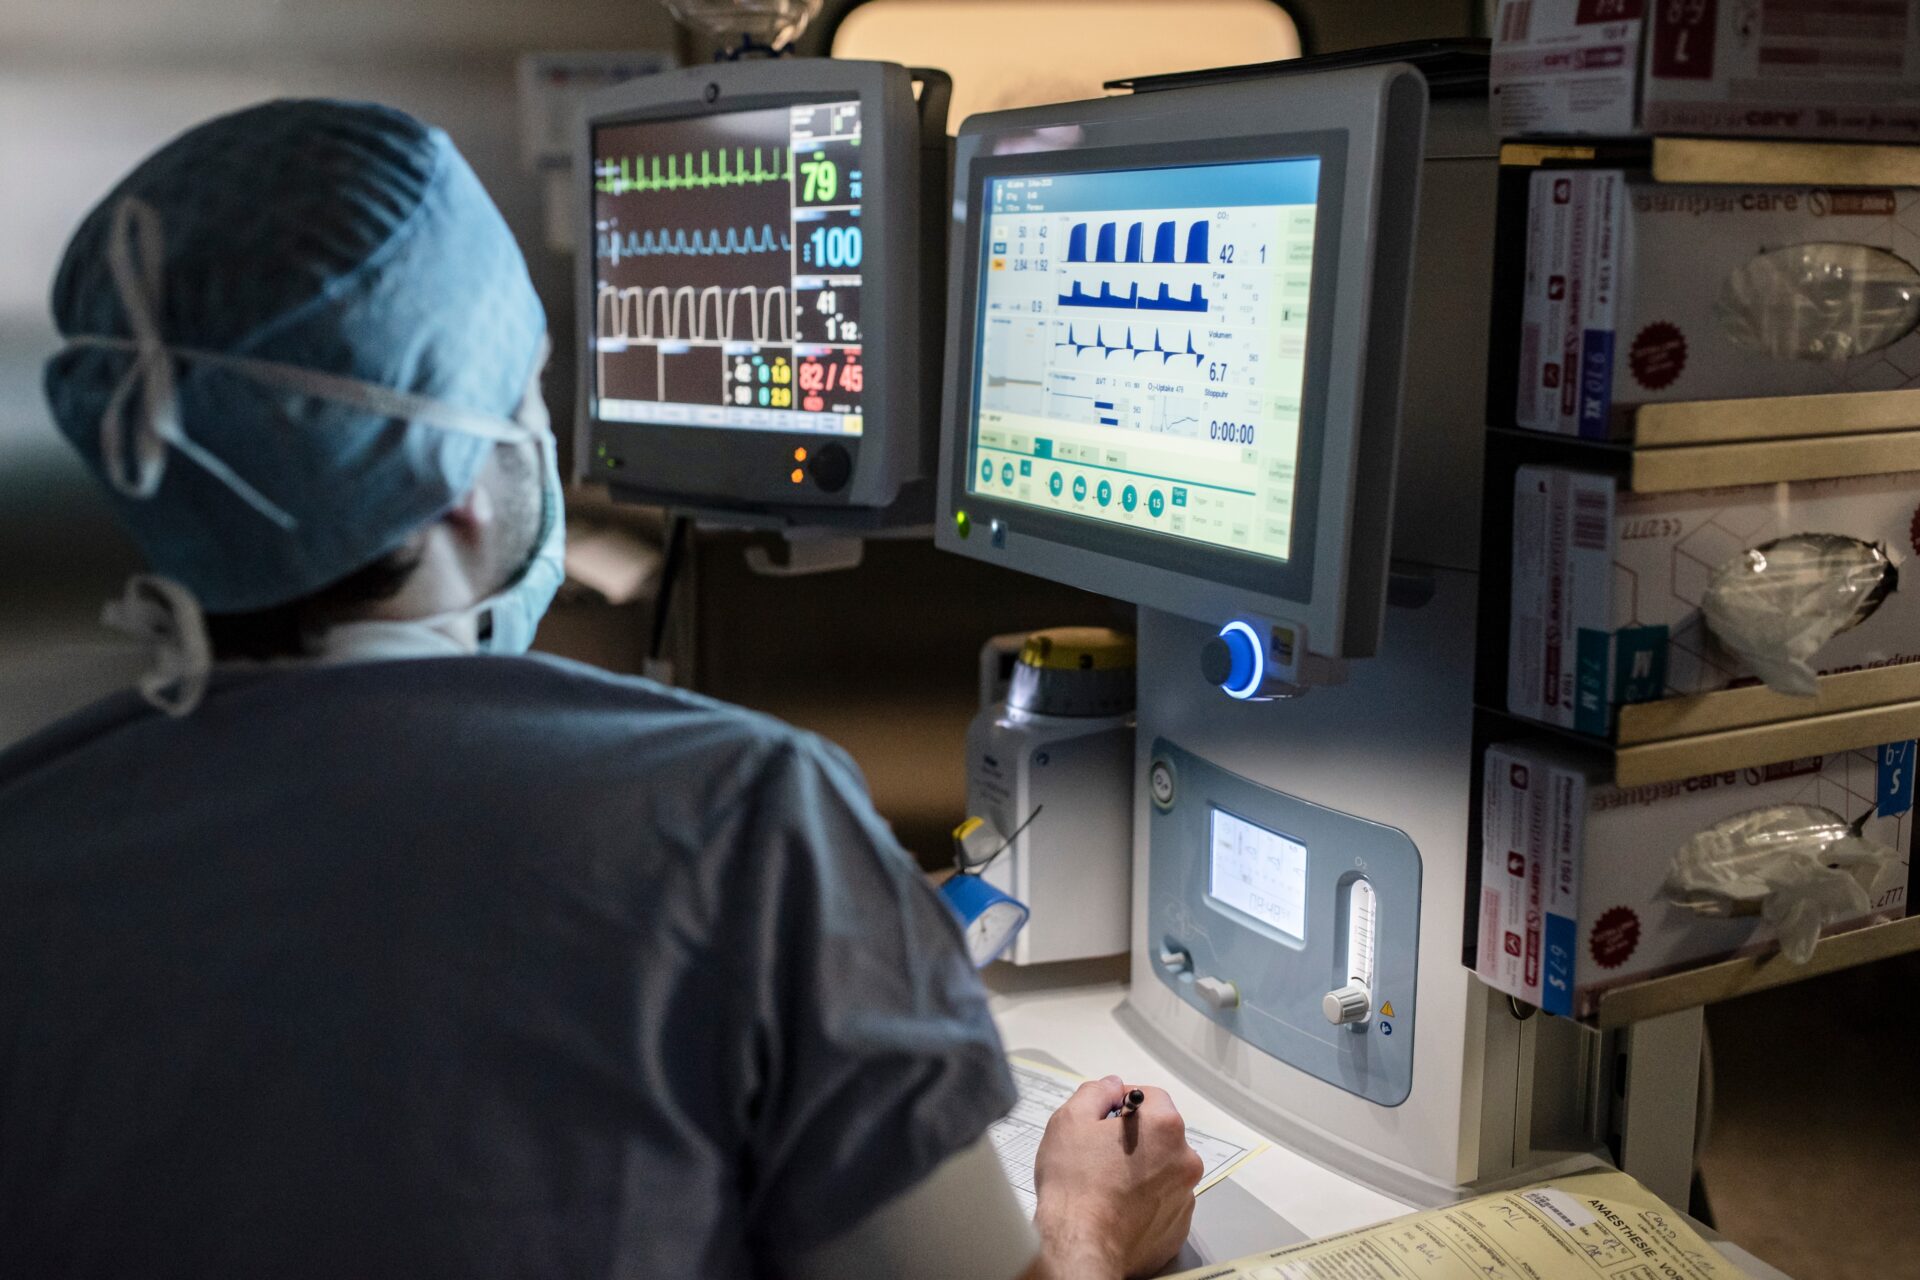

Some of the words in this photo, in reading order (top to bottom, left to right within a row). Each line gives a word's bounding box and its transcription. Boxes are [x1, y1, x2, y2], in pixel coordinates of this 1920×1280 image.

[800, 160, 837, 202] 79
[811, 226, 863, 267] 100
[1219, 244, 1235, 264] 42
[1260, 244, 1266, 264] 1
[1208, 331, 1232, 340] Volumen
[1209, 362, 1227, 382] 6.7
[1204, 388, 1228, 399] Stoppuhr
[1210, 420, 1254, 445] 0:00:00
[1890, 768, 1902, 795] S
[1550, 975, 1567, 991] S
[1588, 1200, 1657, 1258] ANAESTHESIE
